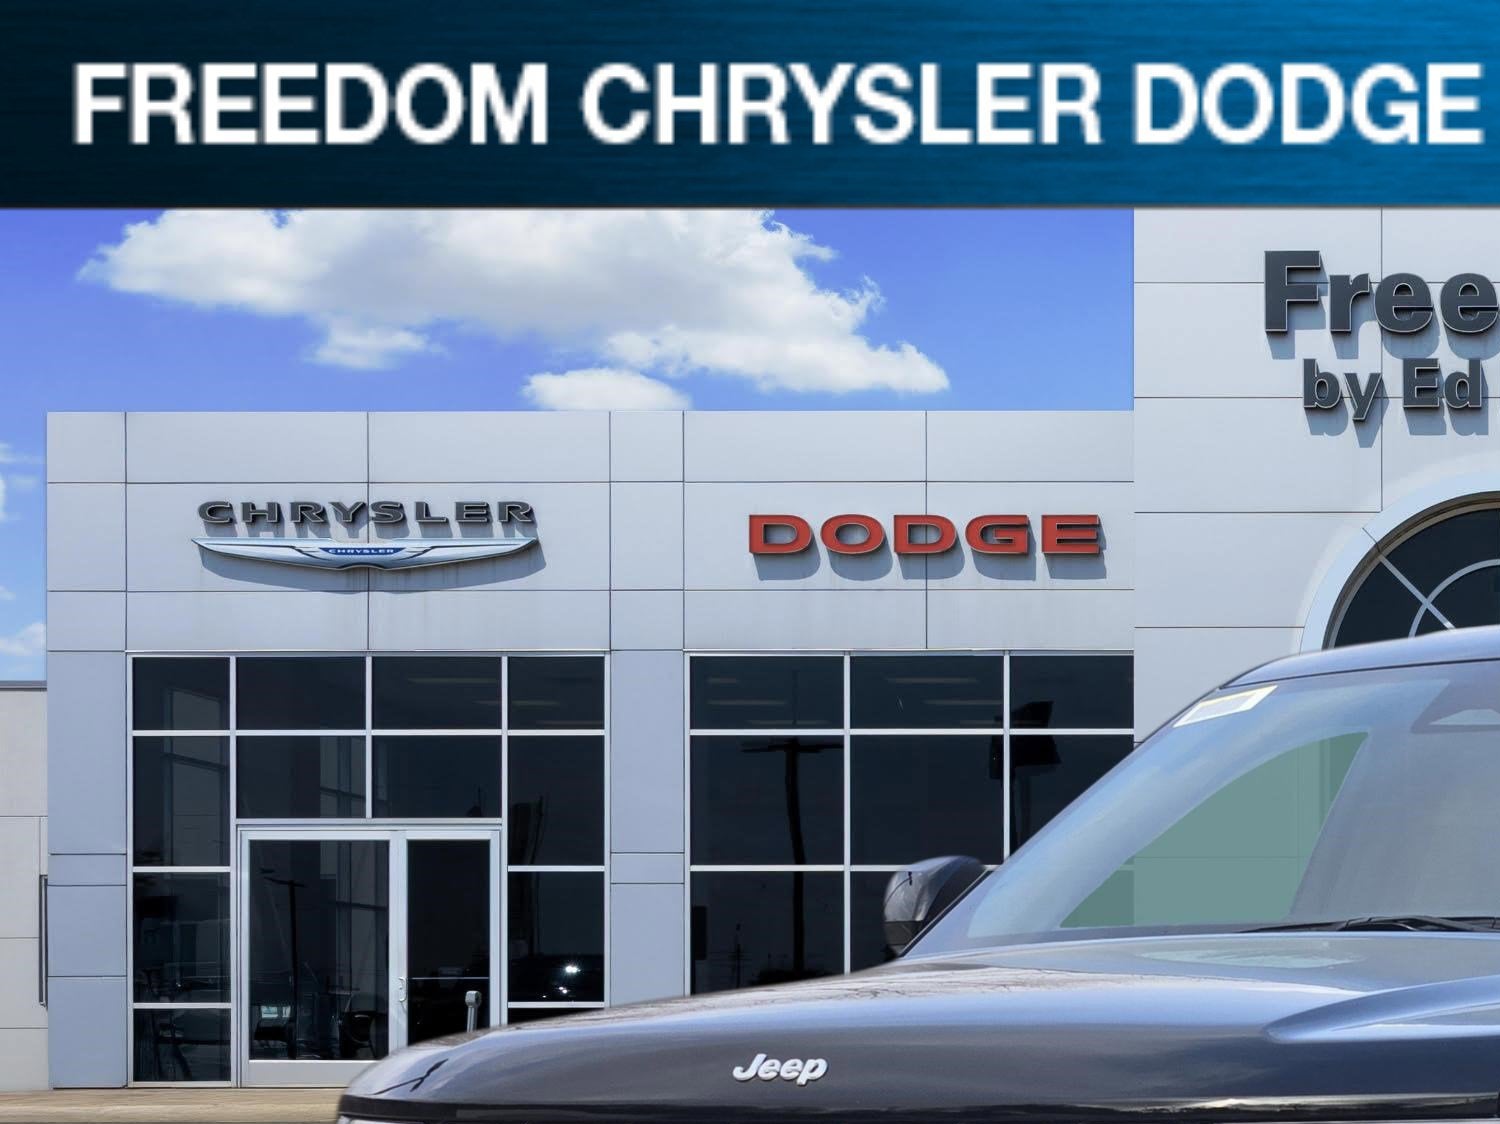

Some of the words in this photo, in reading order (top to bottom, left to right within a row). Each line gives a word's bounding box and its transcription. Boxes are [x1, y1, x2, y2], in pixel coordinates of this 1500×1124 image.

[1301, 358, 1384, 422] by
[1402, 358, 1483, 412] Ed
[197, 500, 535, 525] CHRYSLER
[748, 513, 1101, 555] DODGE
[732, 1053, 828, 1086] Jeep
